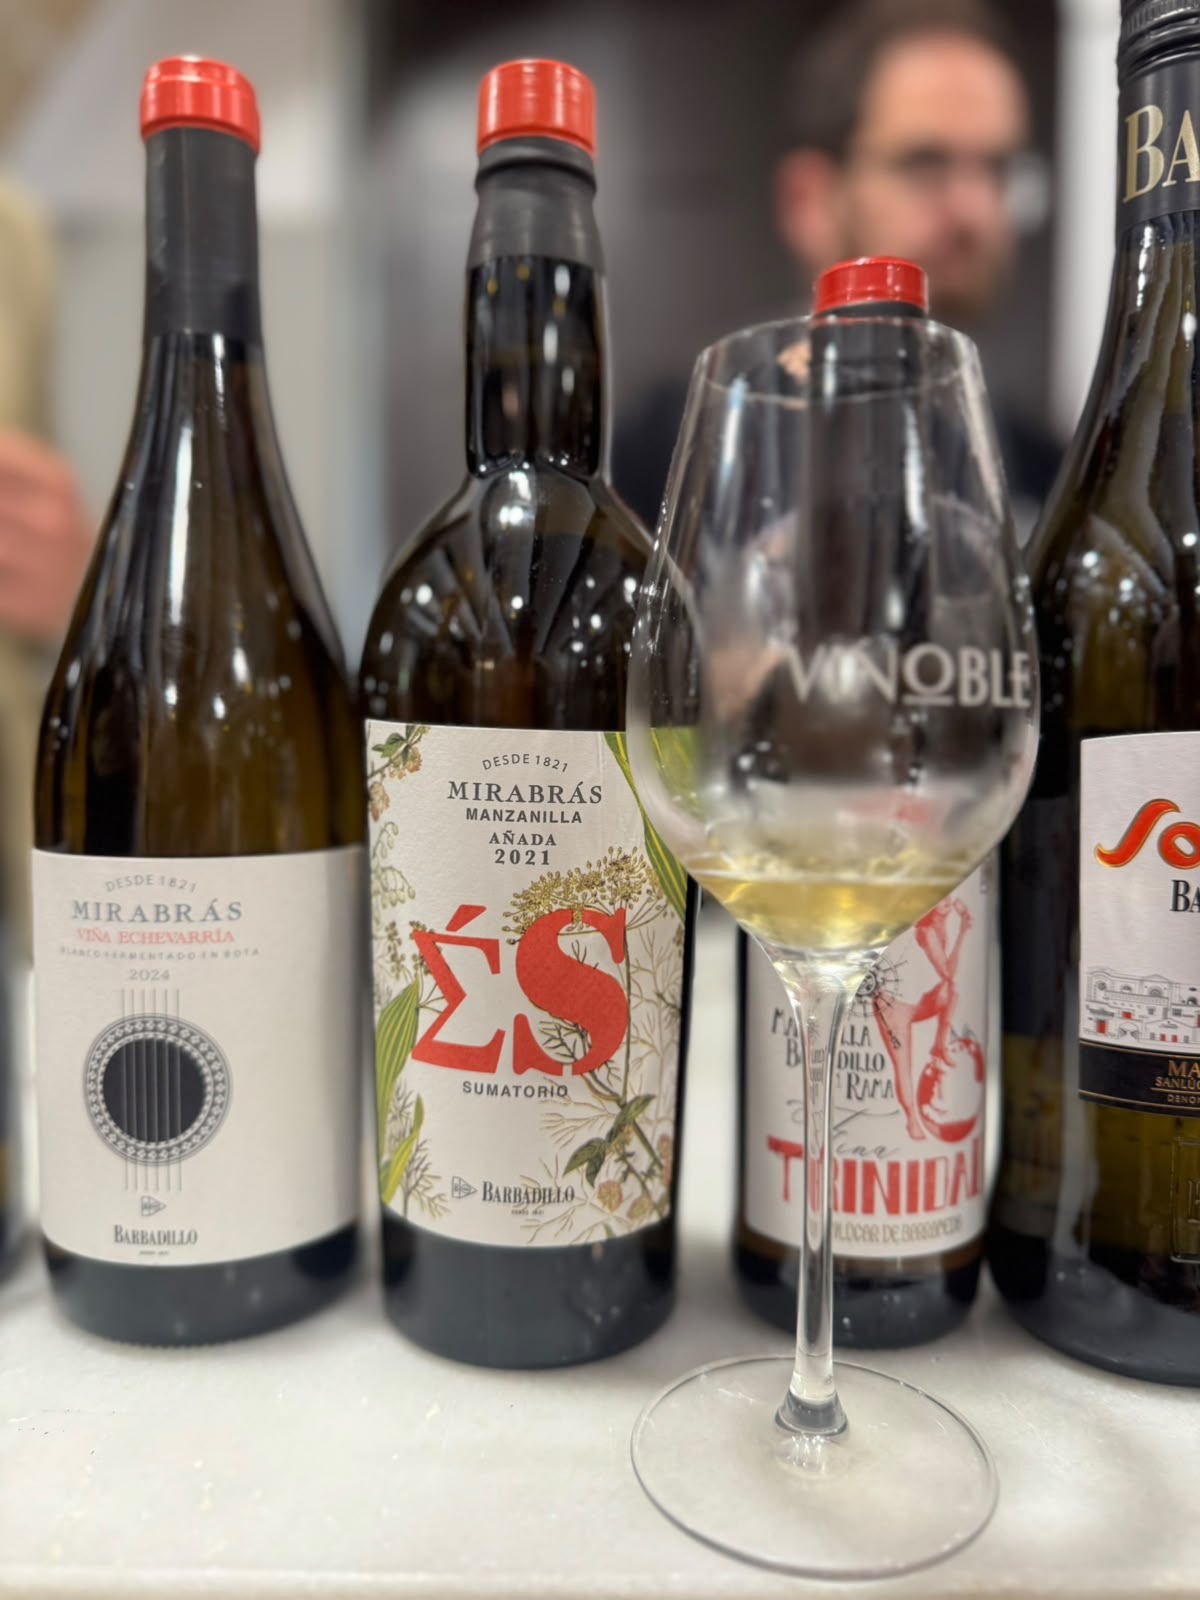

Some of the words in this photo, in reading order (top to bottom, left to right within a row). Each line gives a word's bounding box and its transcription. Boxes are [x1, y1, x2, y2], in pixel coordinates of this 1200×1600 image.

[780, 641, 1032, 707] VINOBLE
[482, 753, 530, 771] DESDE
[535, 755, 568, 773] 1821
[447, 781, 602, 804] MIRABRÁS
[466, 807, 582, 824] MANZANILLA
[489, 830, 557, 846] AÑADA
[494, 849, 550, 866] 2021
[104, 874, 155, 893] DESDE
[159, 875, 197, 893] 1821
[72, 898, 243, 924] MIRABRÁS
[77, 927, 112, 944] VIÑA
[118, 928, 235, 945] ECHEVARRÍA
[129, 968, 171, 982] 2024
[462, 1080, 569, 1098] SUMATORIO
[846, 1072, 894, 1101] RAMA
[483, 1181, 575, 1205] BARBADILLO
[114, 1223, 199, 1246] BARBADILLO
